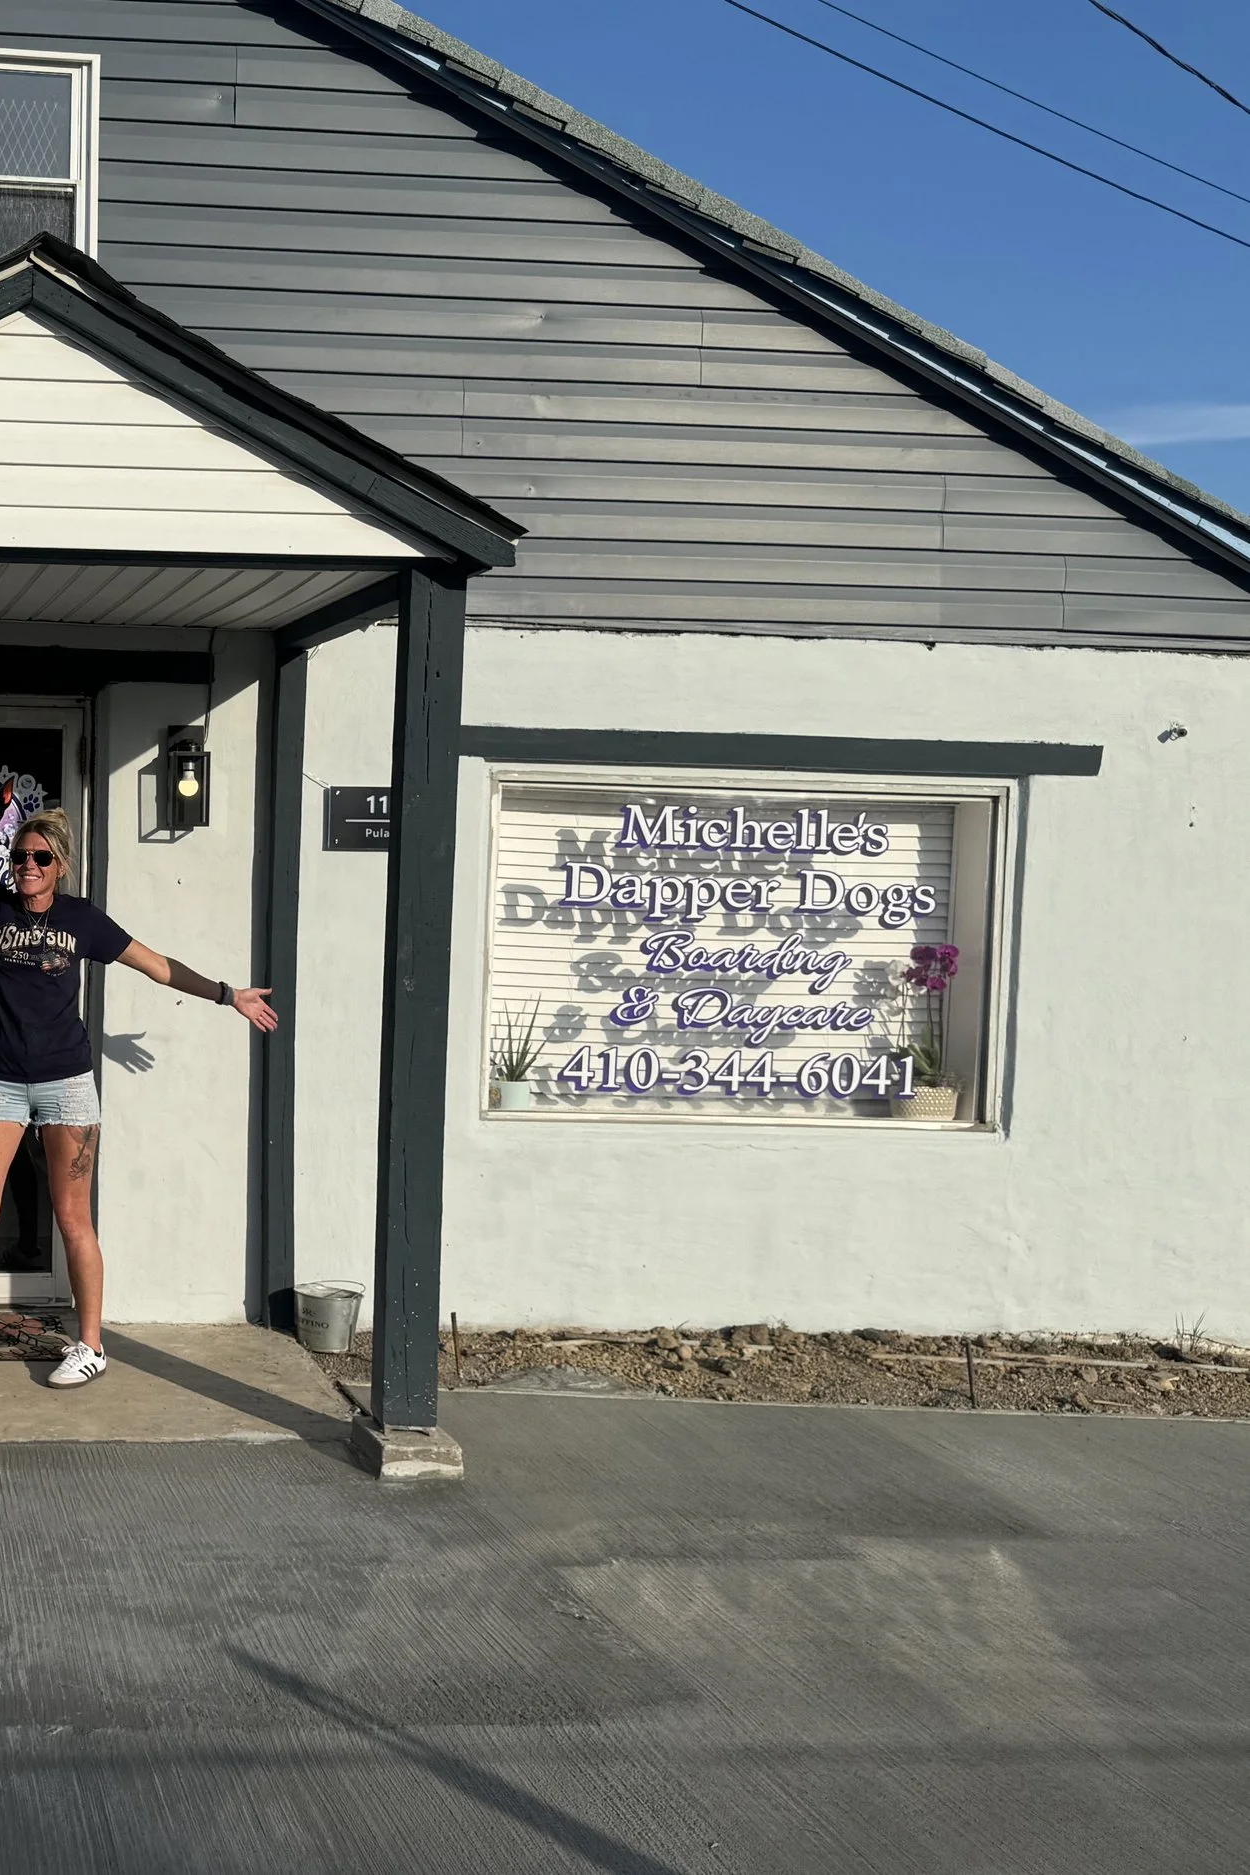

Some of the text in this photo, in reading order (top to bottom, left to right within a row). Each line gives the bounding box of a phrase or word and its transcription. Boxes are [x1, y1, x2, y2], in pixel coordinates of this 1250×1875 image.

[618, 804, 889, 855] Michelle's
[559, 861, 936, 929] Dapper Dogs
[4, 957, 36, 966] MARYLAND
[12, 951, 29, 961] 250
[46, 930, 77, 954] SUN
[641, 931, 851, 994] Boarding
[610, 986, 873, 1048] & Daycare
[558, 1045, 916, 1099] 410-344-6041
